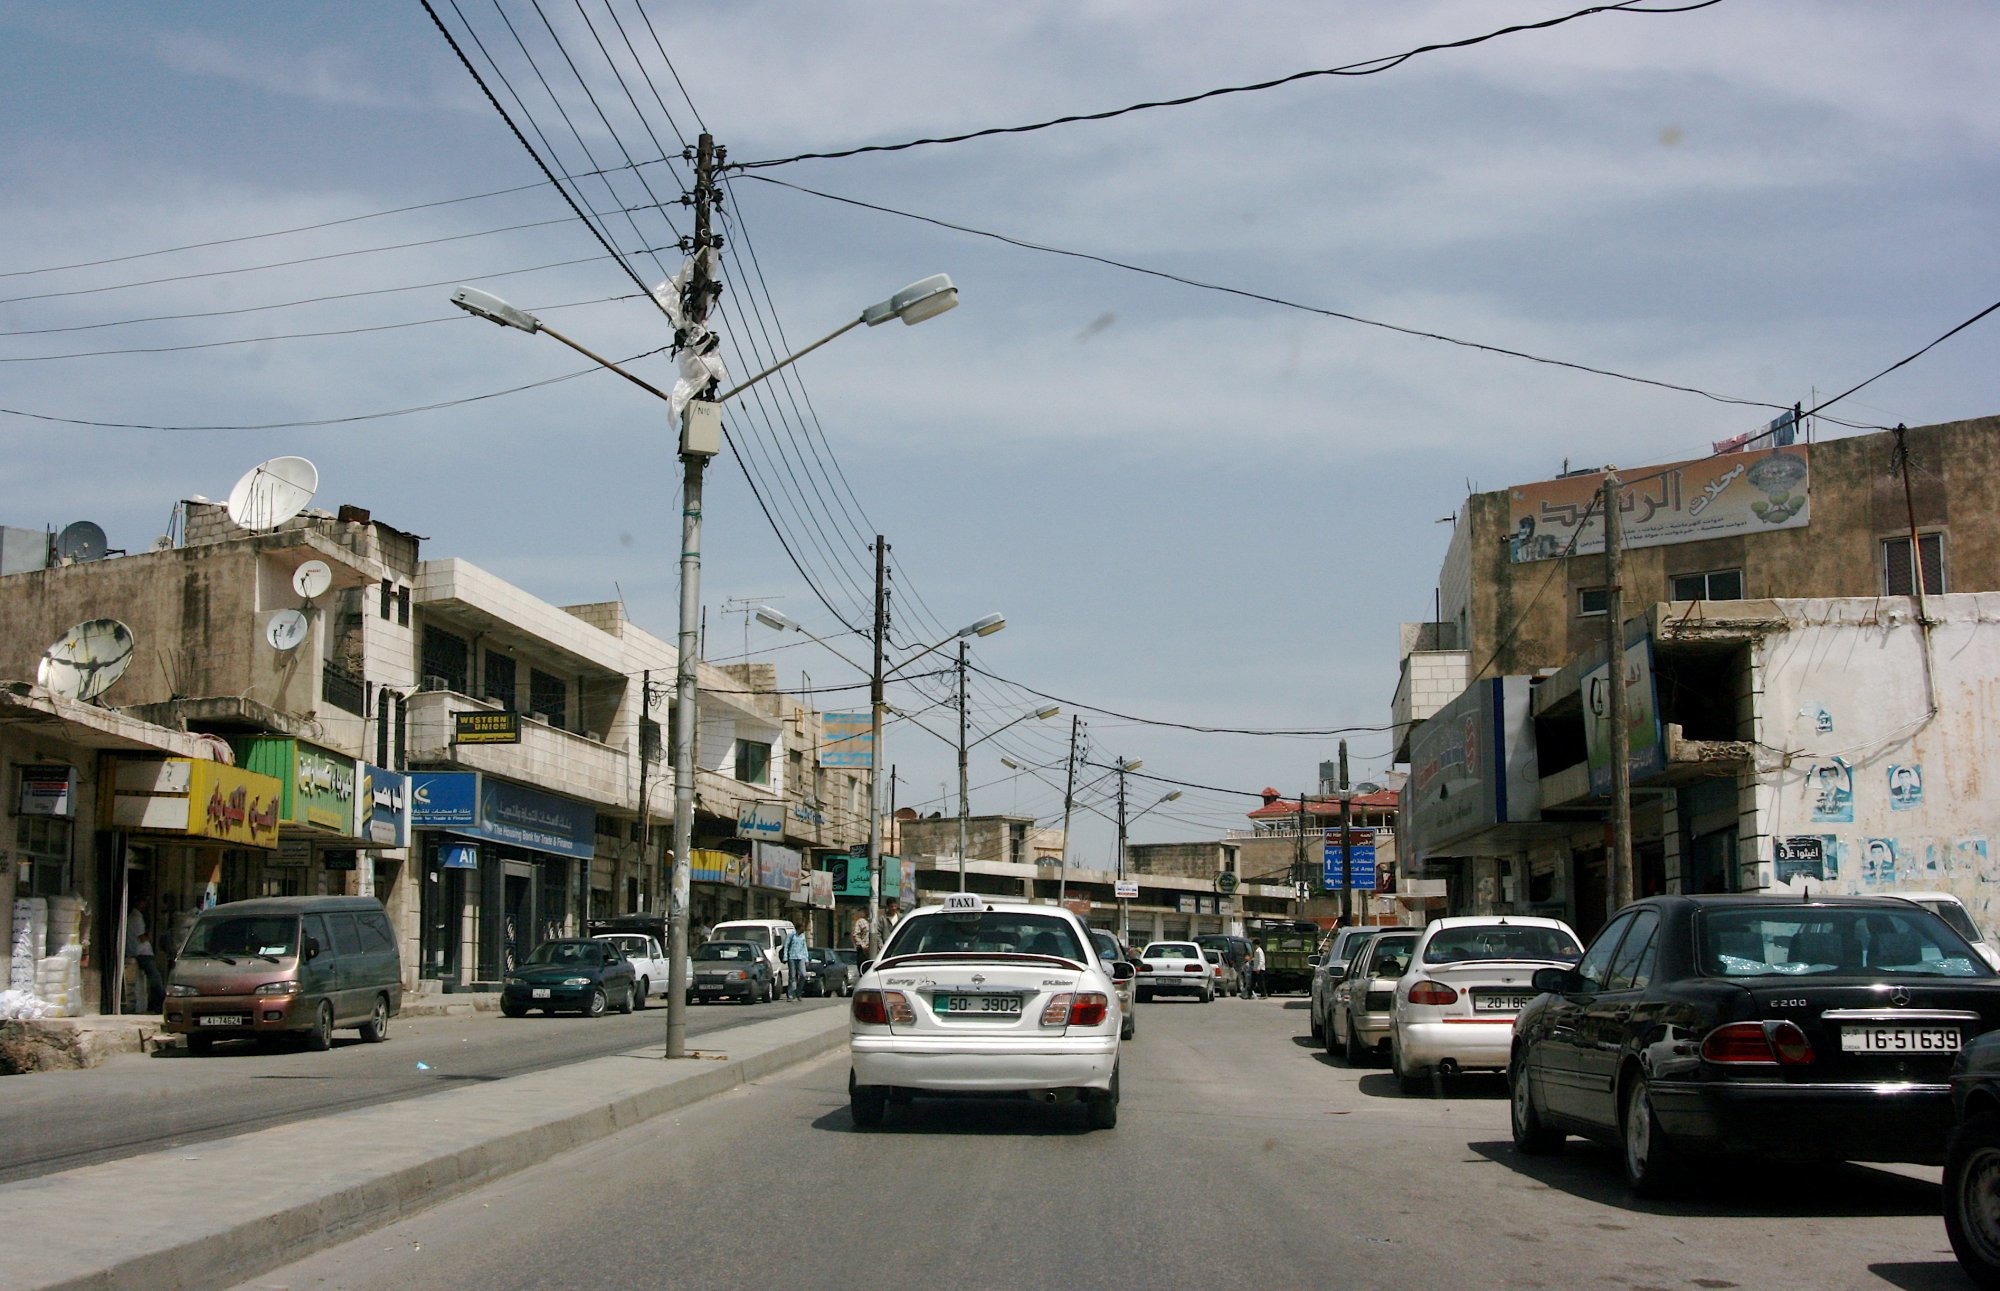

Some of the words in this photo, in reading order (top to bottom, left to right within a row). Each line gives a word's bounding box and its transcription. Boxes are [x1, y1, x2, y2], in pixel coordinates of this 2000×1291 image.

[1689, 461, 1745, 516] محلات
[474, 723, 507, 731] UNION
[494, 823, 503, 836] The
[503, 826, 522, 842] Housing
[523, 830, 534, 841] Bank
[541, 834, 553, 846] Trade
[557, 837, 573, 850] Finance
[1779, 848, 1795, 860] غزة
[1796, 847, 1819, 860] أغيثوا
[949, 897, 975, 908] TAXI
[981, 998, 1019, 1012] 3902
[1864, 1029, 1959, 1050] 16-51639
